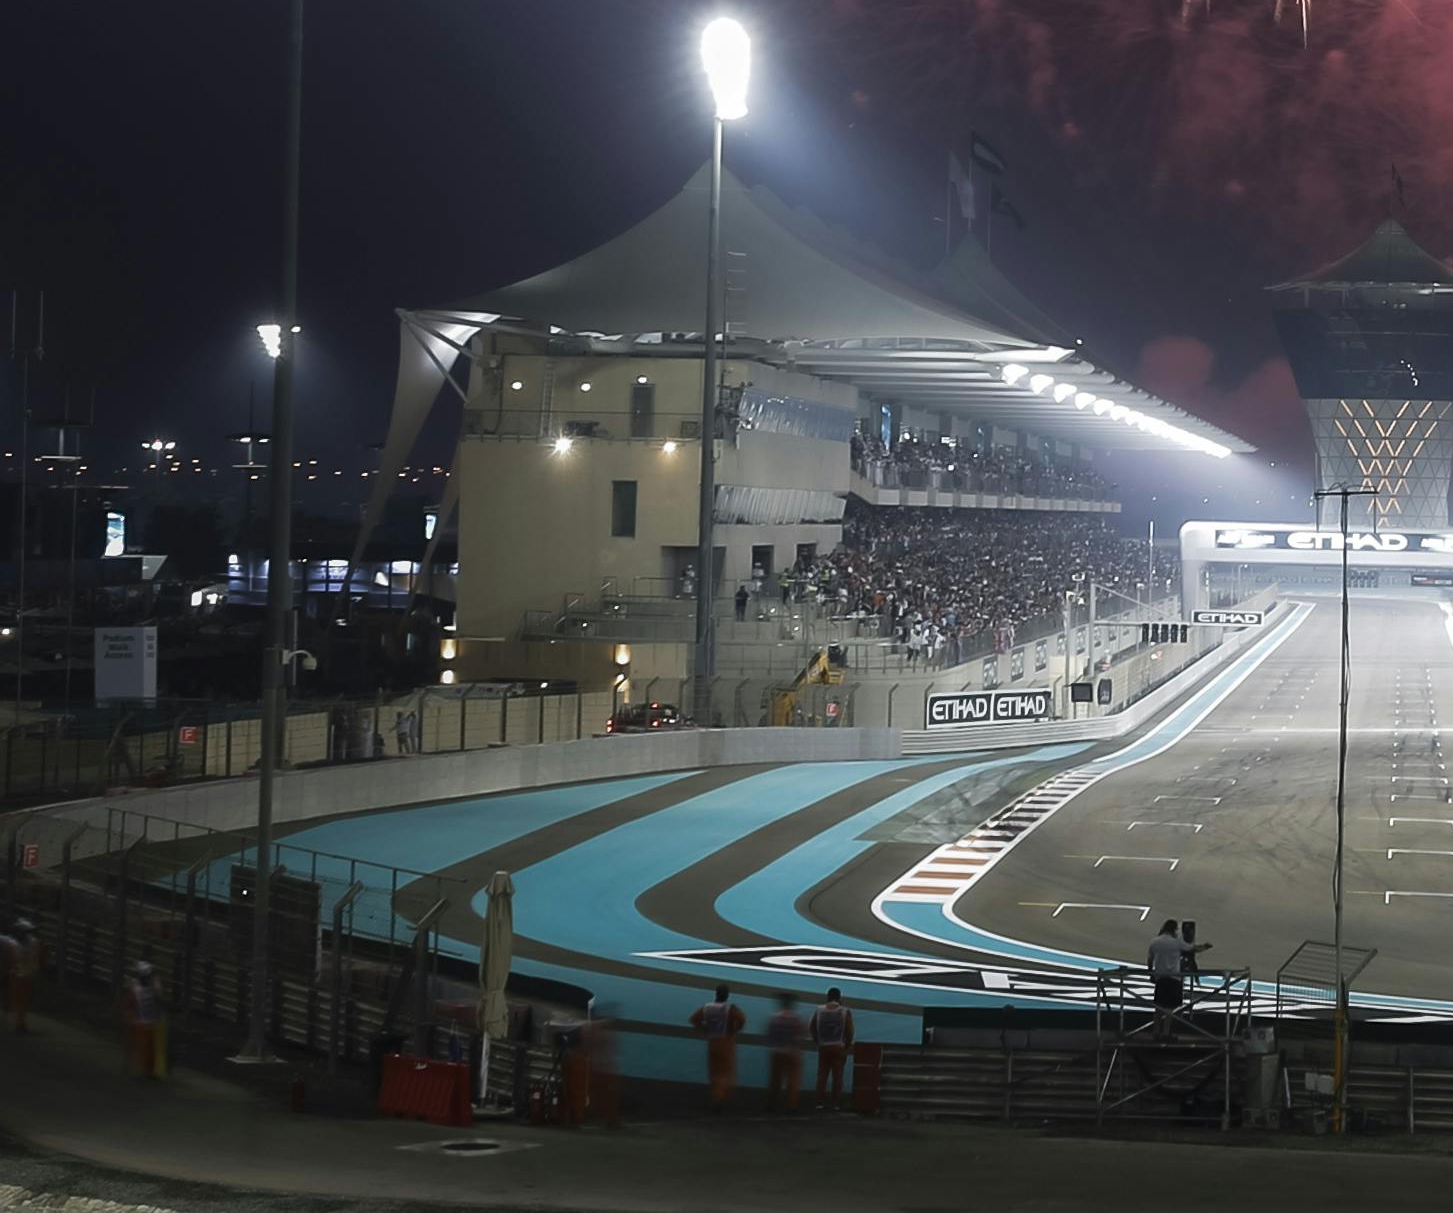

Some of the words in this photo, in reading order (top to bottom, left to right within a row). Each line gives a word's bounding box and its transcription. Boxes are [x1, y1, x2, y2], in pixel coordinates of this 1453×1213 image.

[1287, 532, 1408, 551] ETIHAD
[1197, 613, 1259, 624] ETIHAD
[932, 698, 988, 721] ETIHAD
[996, 695, 1046, 717] ETIHAD
